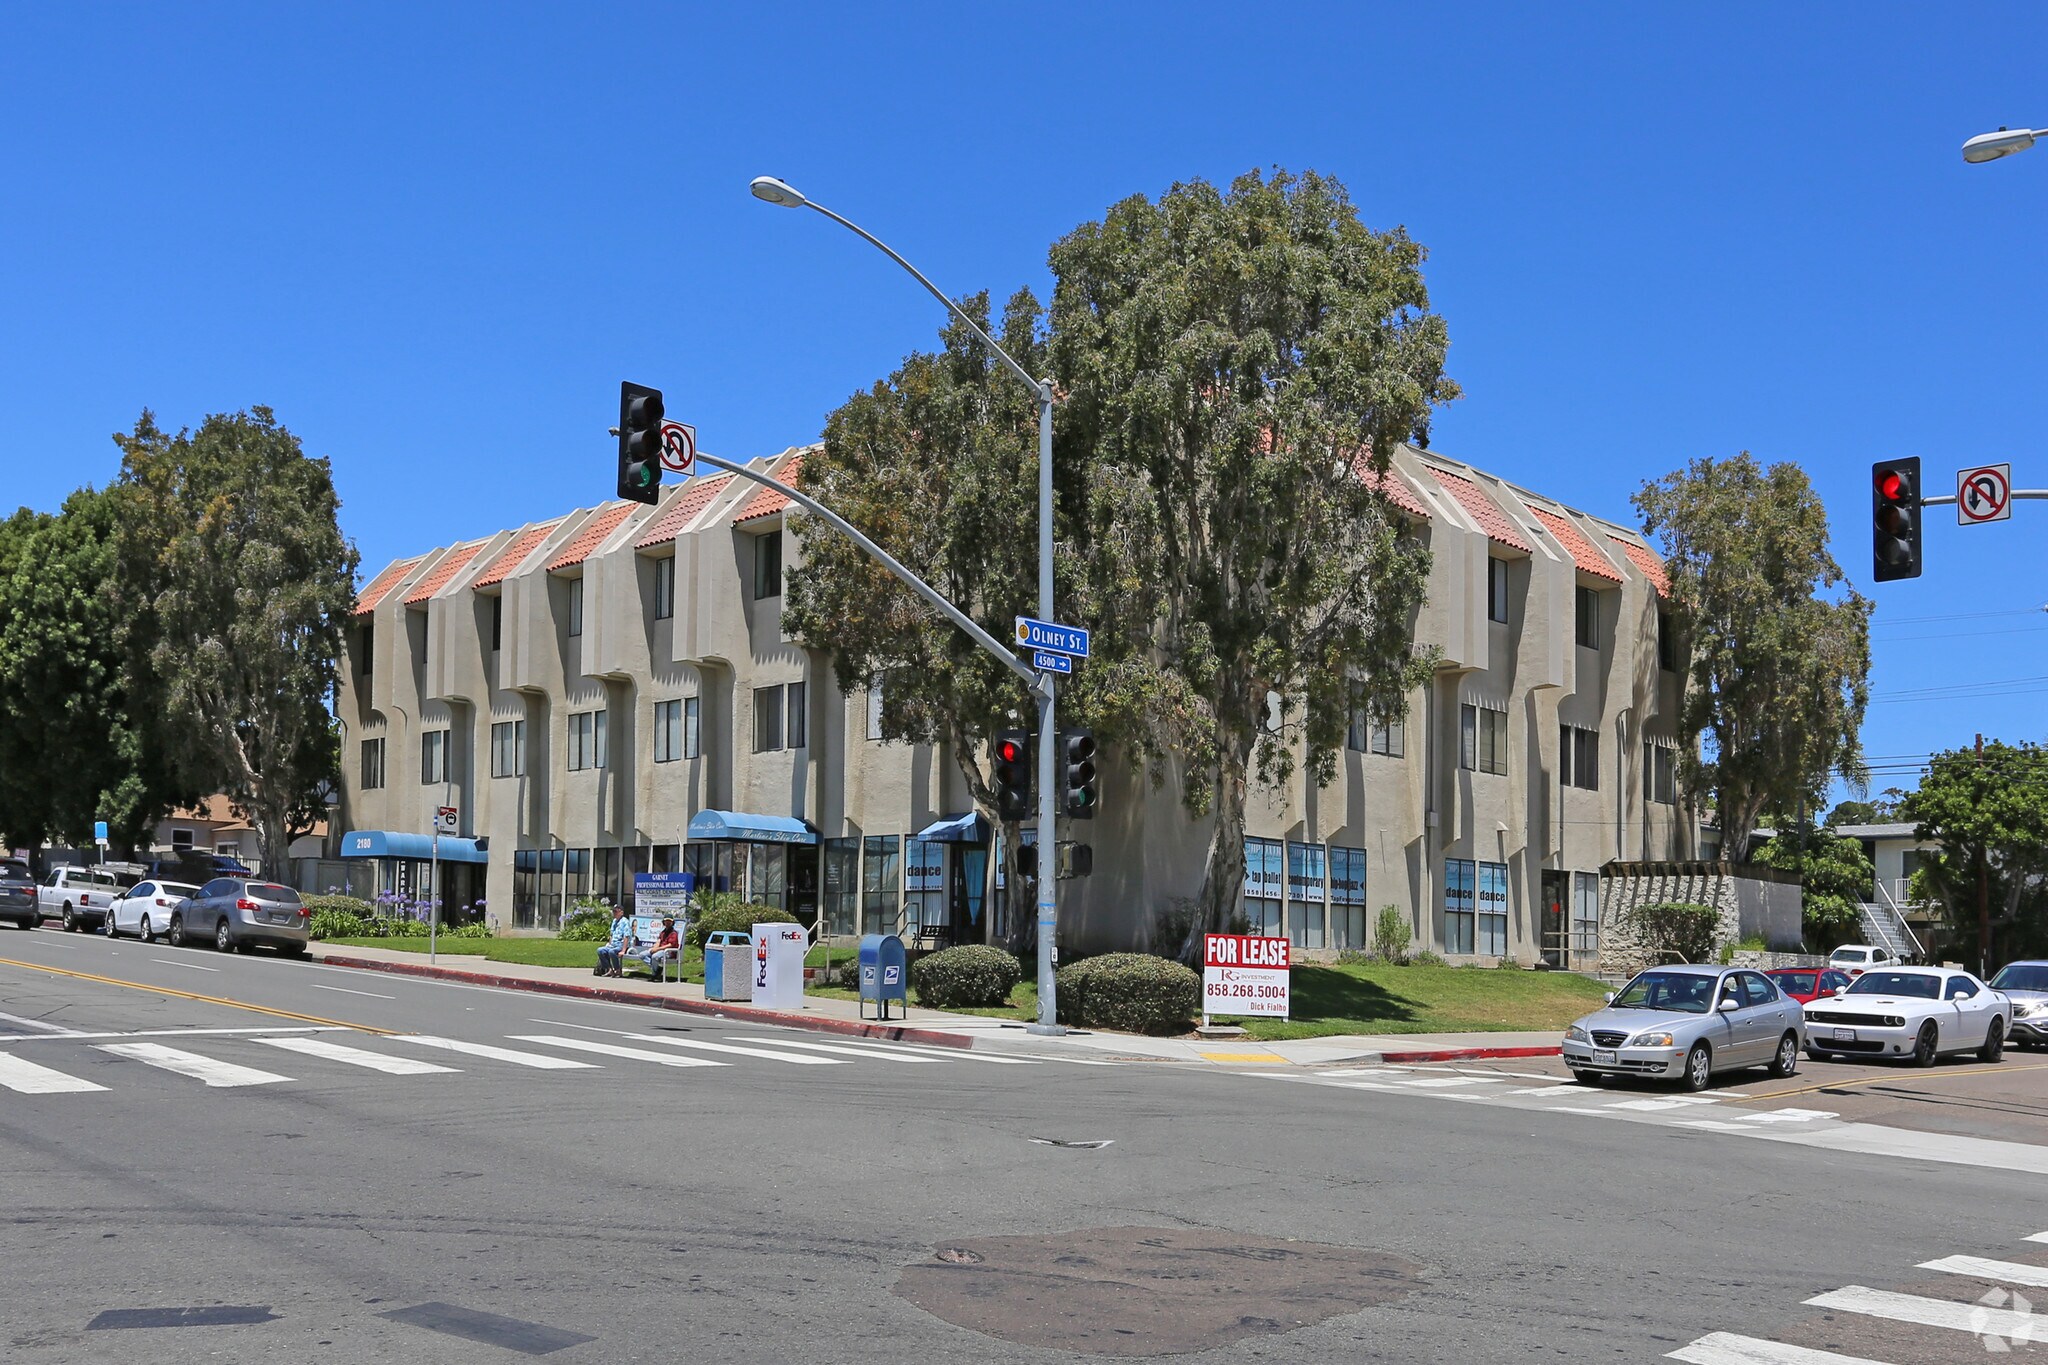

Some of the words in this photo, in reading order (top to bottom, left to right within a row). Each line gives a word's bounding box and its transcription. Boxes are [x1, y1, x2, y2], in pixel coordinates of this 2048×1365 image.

[1032, 626, 1065, 647] OLNEY
[1069, 633, 1084, 650] ST.
[1038, 655, 1056, 668] 4500
[356, 838, 372, 849] 2180
[772, 831, 790, 842] Skin
[791, 832, 807, 843] Care
[907, 864, 942, 877] dance
[1251, 870, 1261, 884] tap
[1264, 869, 1281, 884] ballet
[636, 881, 665, 889] PROFESSIONAL
[1446, 886, 1473, 899] dance
[1480, 890, 1506, 902] dance
[781, 931, 802, 940] FedEx
[1207, 937, 1238, 964] FOR
[1242, 939, 1287, 966] LEASE
[757, 937, 767, 988] FedEx
[1207, 983, 1286, 999] 858.268.5004
[1250, 1002, 1265, 1011] Dick
[1267, 1002, 1287, 1012] Fialho
